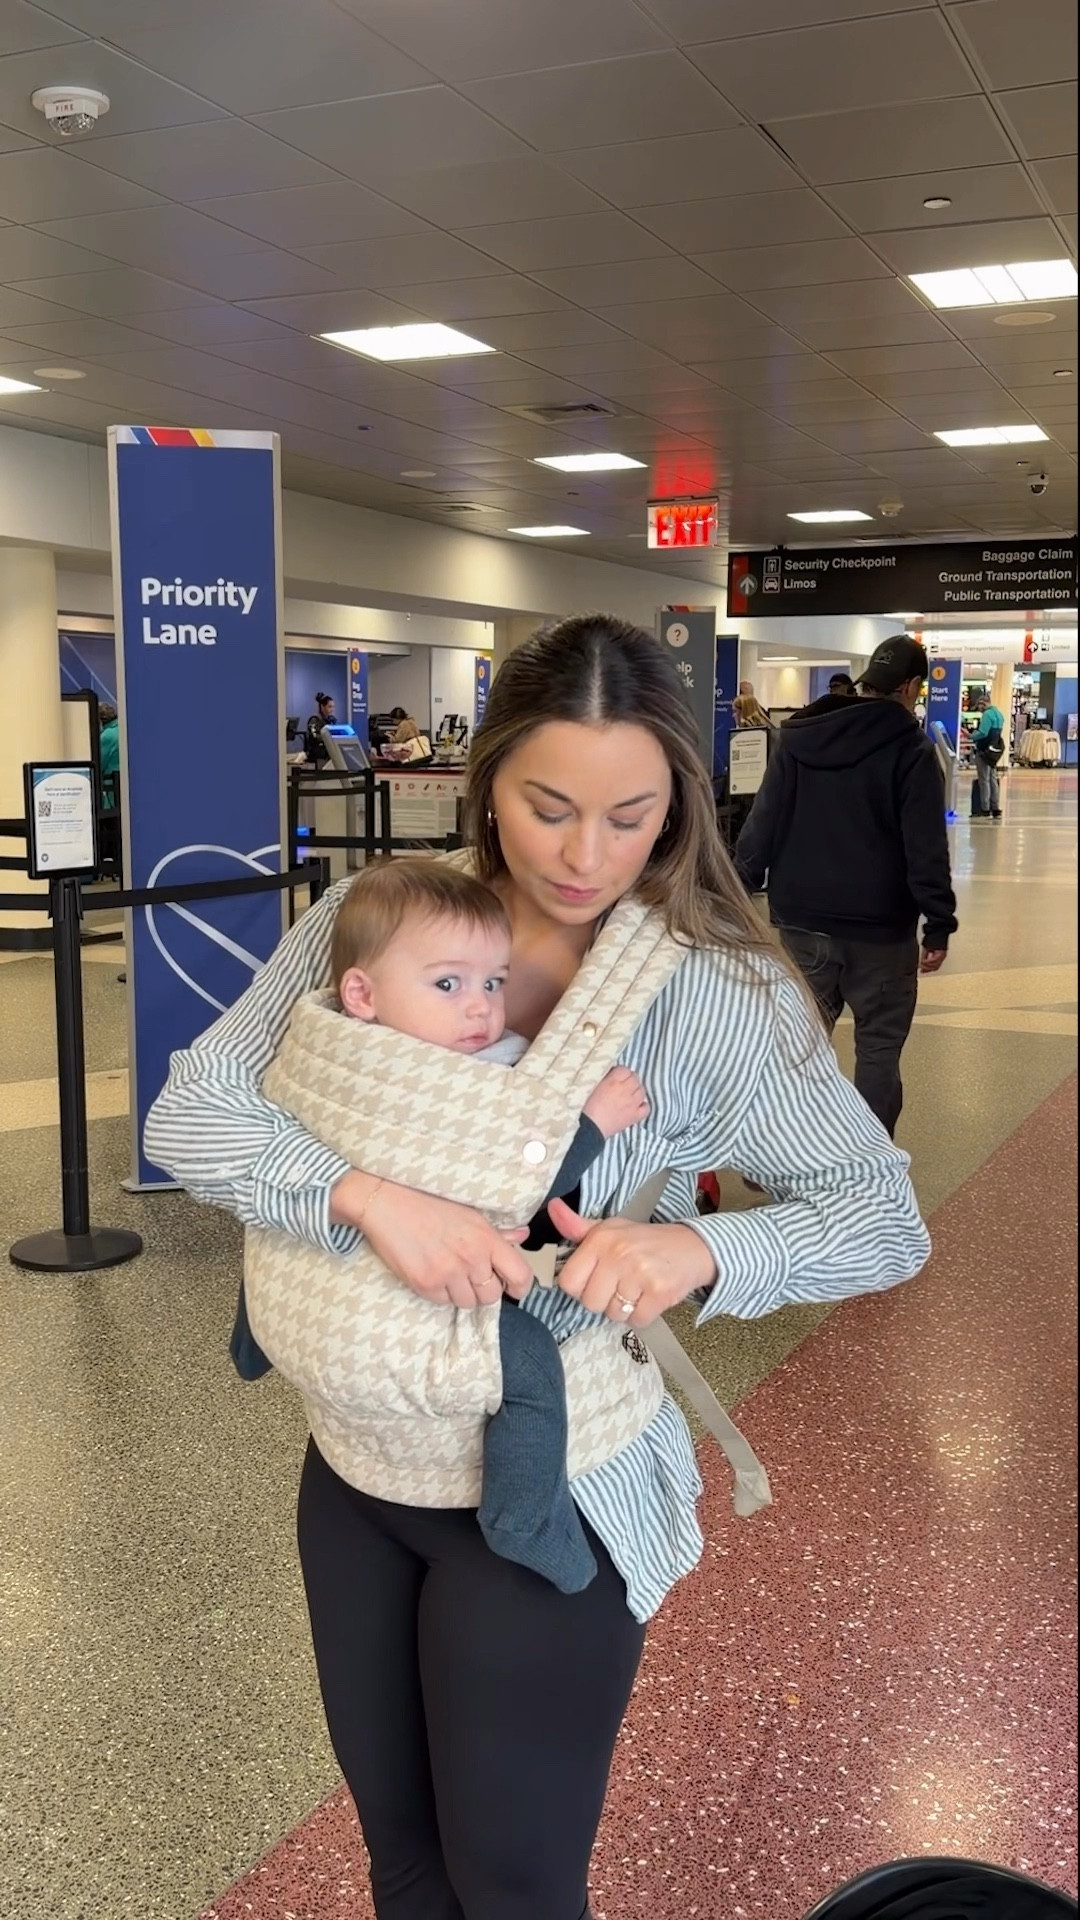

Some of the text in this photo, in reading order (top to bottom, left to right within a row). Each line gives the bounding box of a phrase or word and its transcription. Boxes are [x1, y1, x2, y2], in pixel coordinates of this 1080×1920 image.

[55, 103, 74, 112] FIRE
[656, 504, 712, 546] EXIT
[982, 549, 1074, 563] Baggage Claim
[784, 556, 897, 571] Security Checkpoint
[938, 568, 1073, 583] Ground Transportation
[783, 579, 817, 589] Limos
[141, 577, 258, 614] Priority
[944, 588, 1071, 602] Public Transportation
[143, 617, 217, 645] Lane
[675, 661, 693, 675] elp
[931, 686, 949, 694] Start
